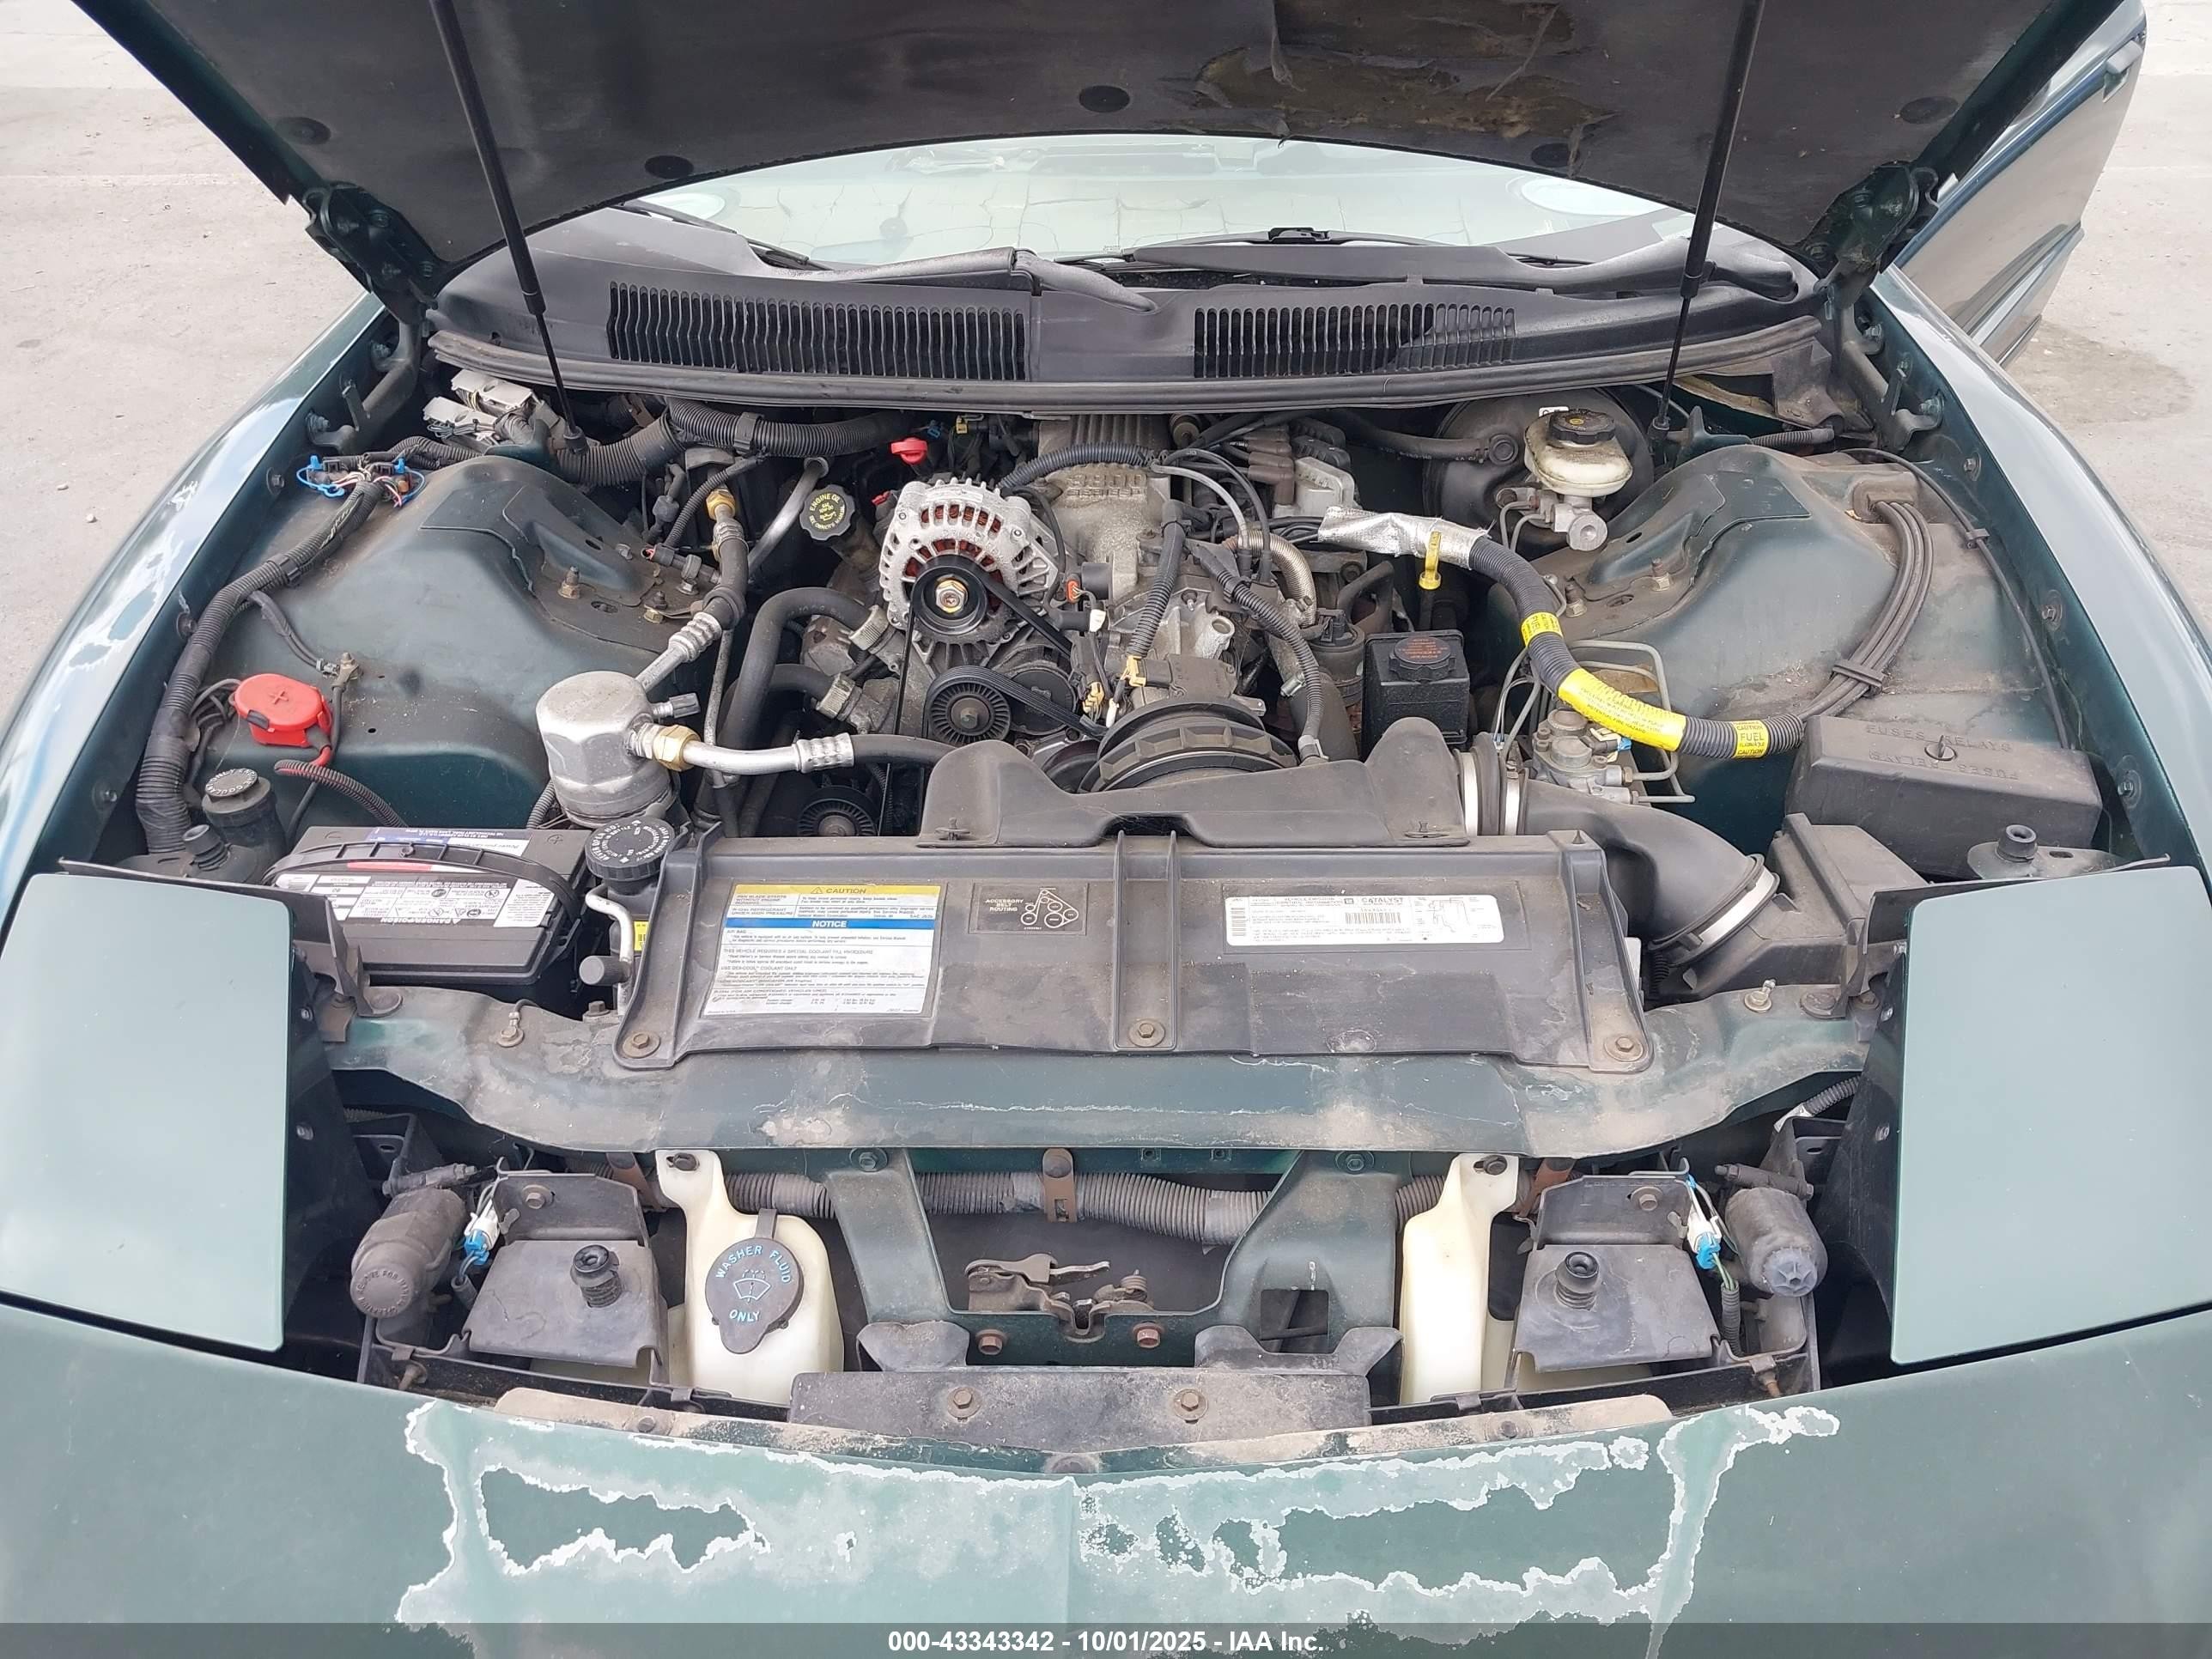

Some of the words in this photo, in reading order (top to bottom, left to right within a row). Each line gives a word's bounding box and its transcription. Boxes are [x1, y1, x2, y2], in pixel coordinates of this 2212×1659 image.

[810, 493, 831, 512] ENGINE
[831, 494, 841, 503] OIL
[1740, 732, 1765, 742] FUEL
[1866, 724, 1925, 741] FUSES
[1944, 735, 2013, 753] RELAYS
[210, 769, 235, 782] ONLY
[715, 1245, 763, 1279] WASHER
[769, 1249, 792, 1283] FLUID
[729, 1309, 761, 1322] ONLY
